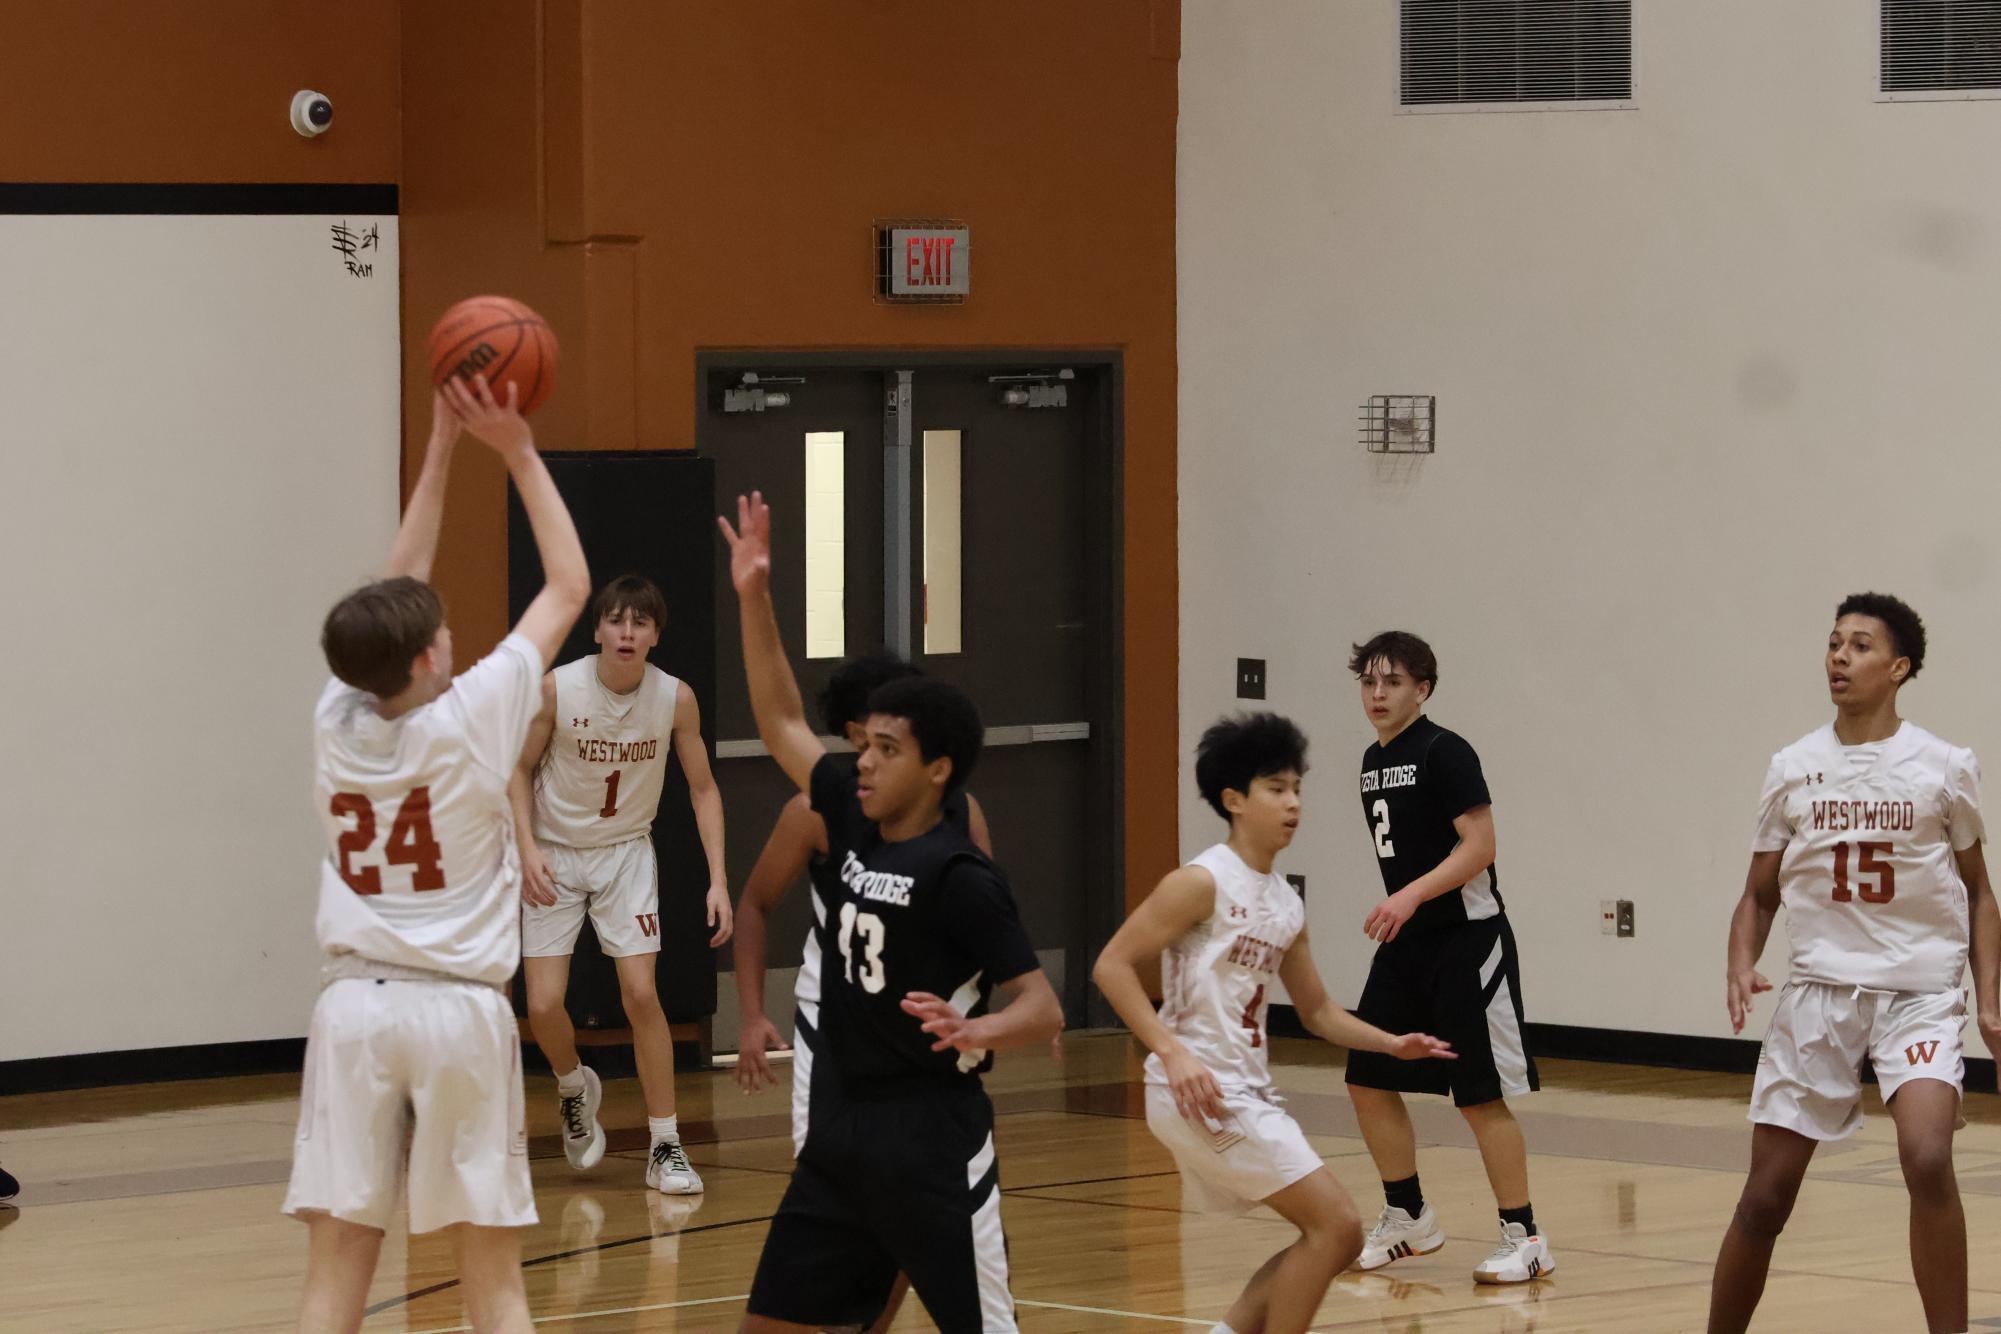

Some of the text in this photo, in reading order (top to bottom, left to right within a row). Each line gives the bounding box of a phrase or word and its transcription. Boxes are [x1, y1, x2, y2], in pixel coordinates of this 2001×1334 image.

[344, 261, 373, 278] RAM
[906, 238, 955, 286] EXIT
[577, 739, 657, 762] WESTWOOD
[600, 770, 620, 818] 1
[1382, 764, 1417, 789] RIDGE
[1372, 798, 1396, 858] 2
[1812, 801, 1914, 831] WESTWOOD
[330, 785, 446, 896] 24
[1831, 841, 1895, 904] 15
[1904, 1040, 1941, 1066] W
